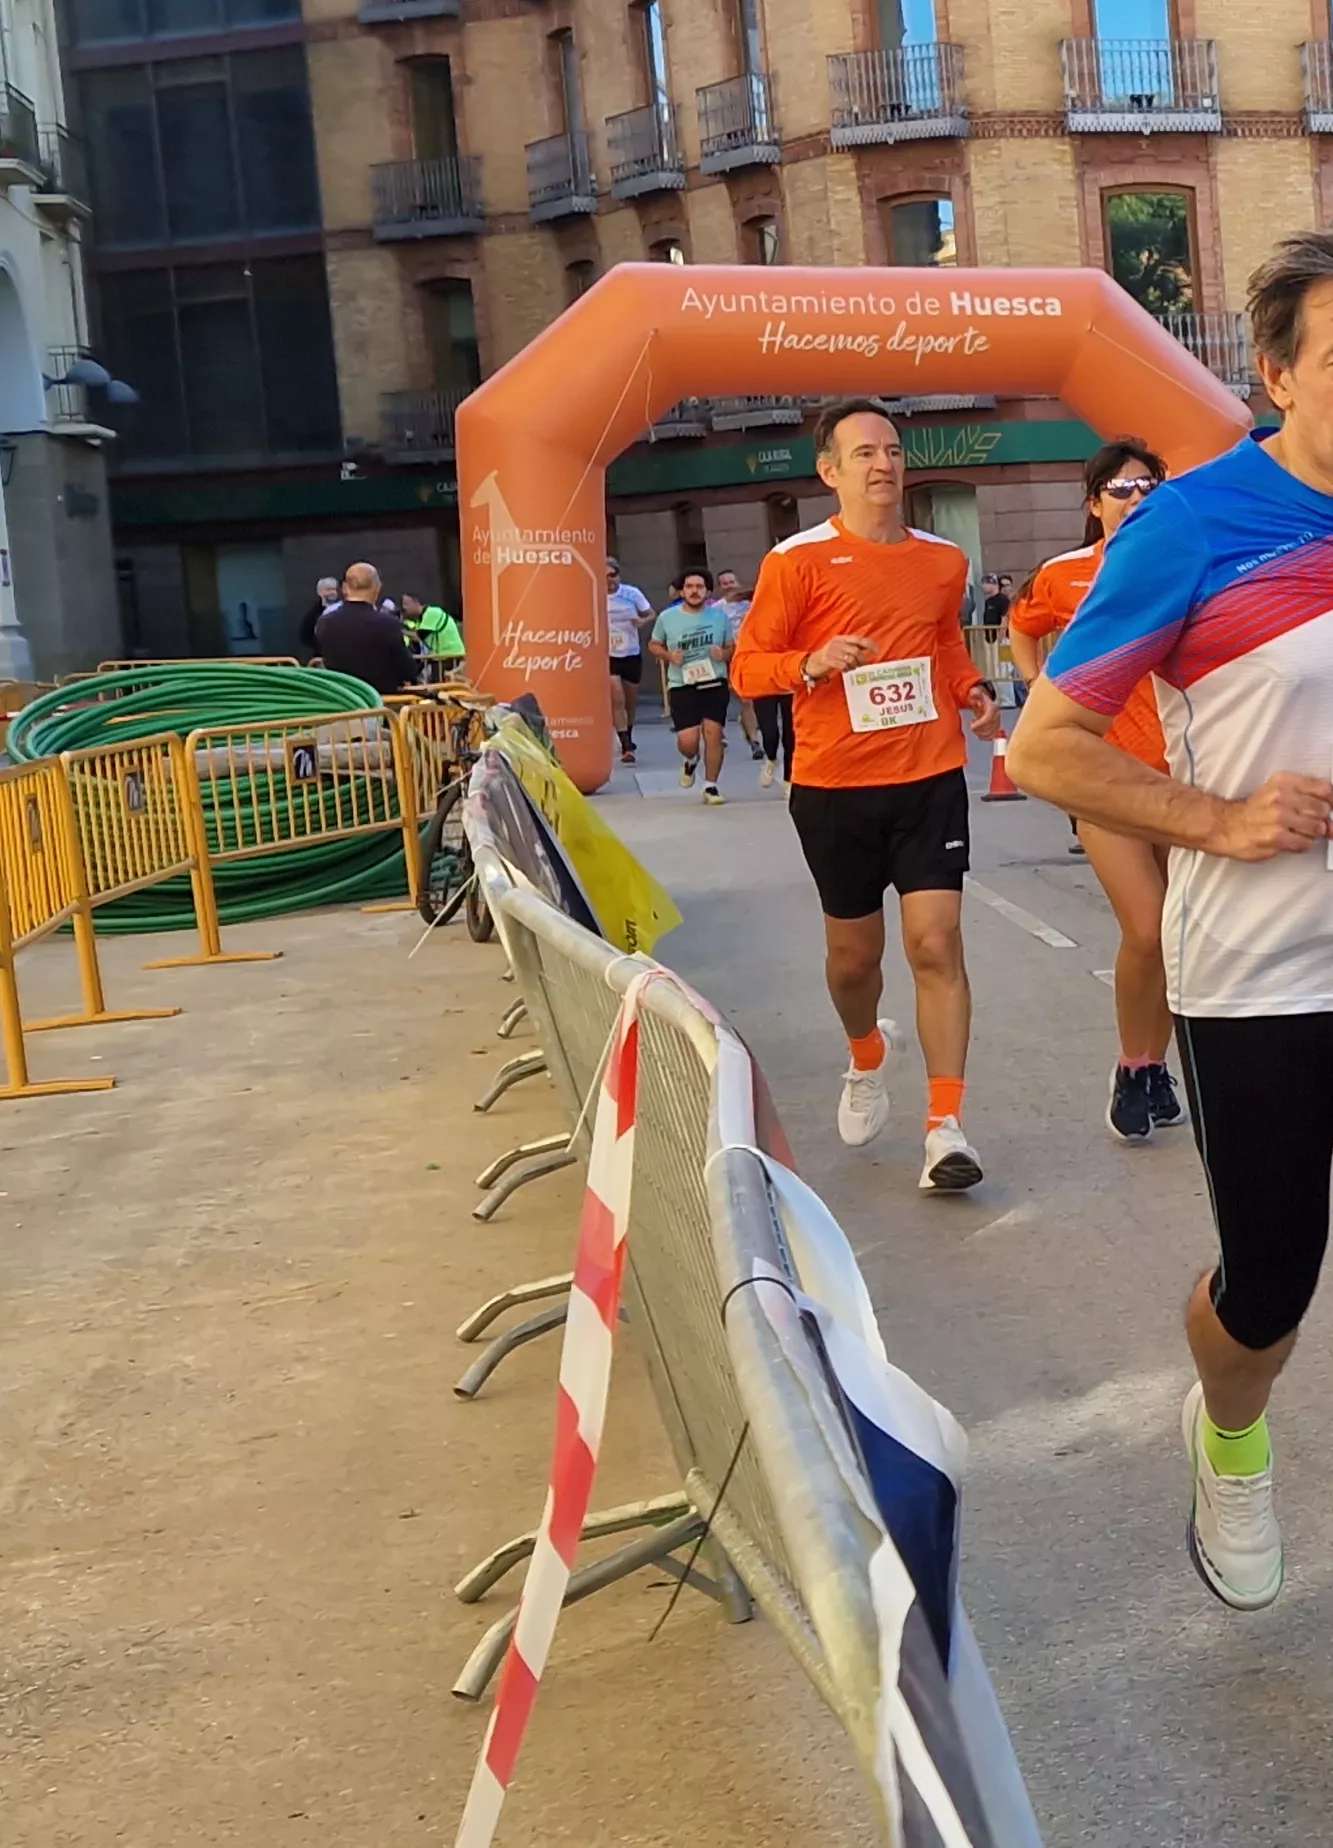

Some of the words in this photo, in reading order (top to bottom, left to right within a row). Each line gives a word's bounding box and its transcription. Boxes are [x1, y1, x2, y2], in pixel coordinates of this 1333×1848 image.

[680, 287, 896, 319] Ayuntamiento
[905, 292, 940, 316] de
[949, 291, 1063, 316] Huesca
[758, 321, 884, 358] Hacemos
[886, 321, 990, 366] deporte
[472, 525, 596, 546] Ayuntamiento
[473, 547, 491, 565] de
[496, 548, 573, 565] Huesca
[501, 619, 592, 649] Hacemos
[502, 646, 583, 682] deporte
[868, 682, 917, 706] 632
[879, 703, 914, 717] JESUS
